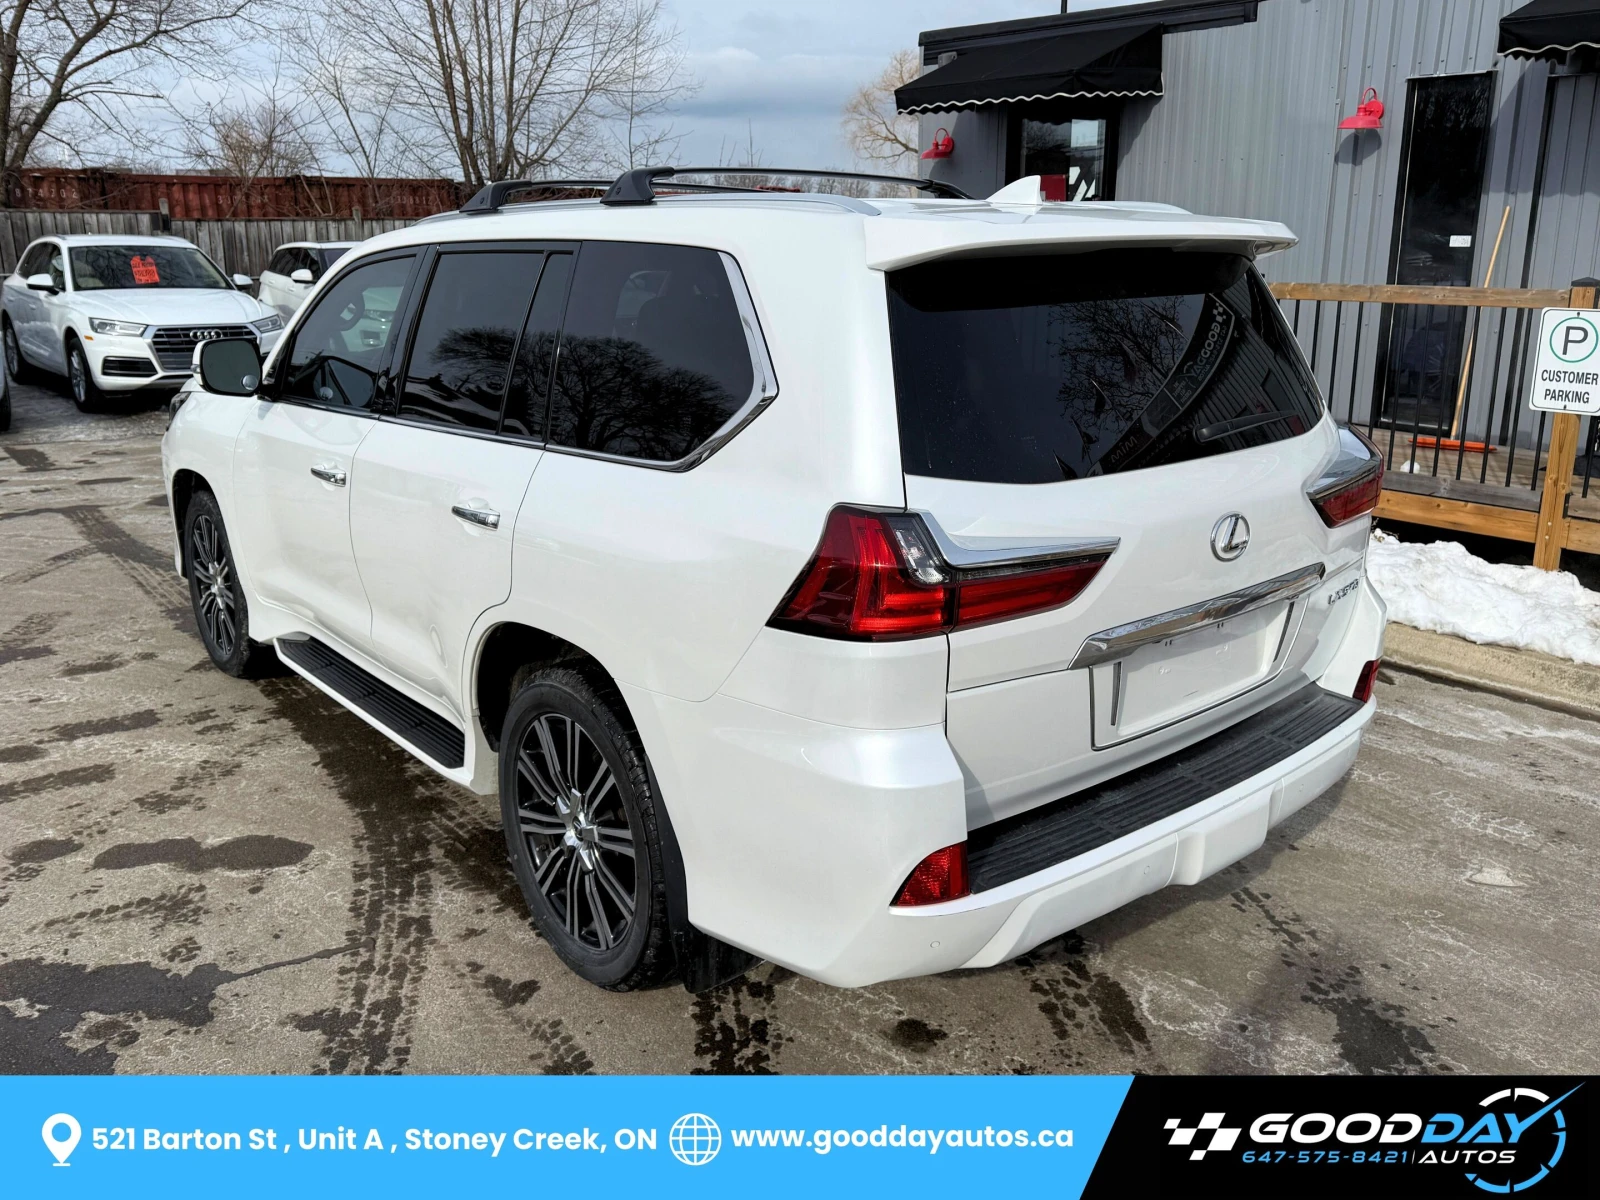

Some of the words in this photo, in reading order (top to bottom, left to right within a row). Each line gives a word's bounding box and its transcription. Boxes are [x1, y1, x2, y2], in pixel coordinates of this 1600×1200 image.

[1562, 326, 1588, 355] P
[1541, 369, 1599, 386] CUSTOMER
[1544, 388, 1590, 404] PARKING
